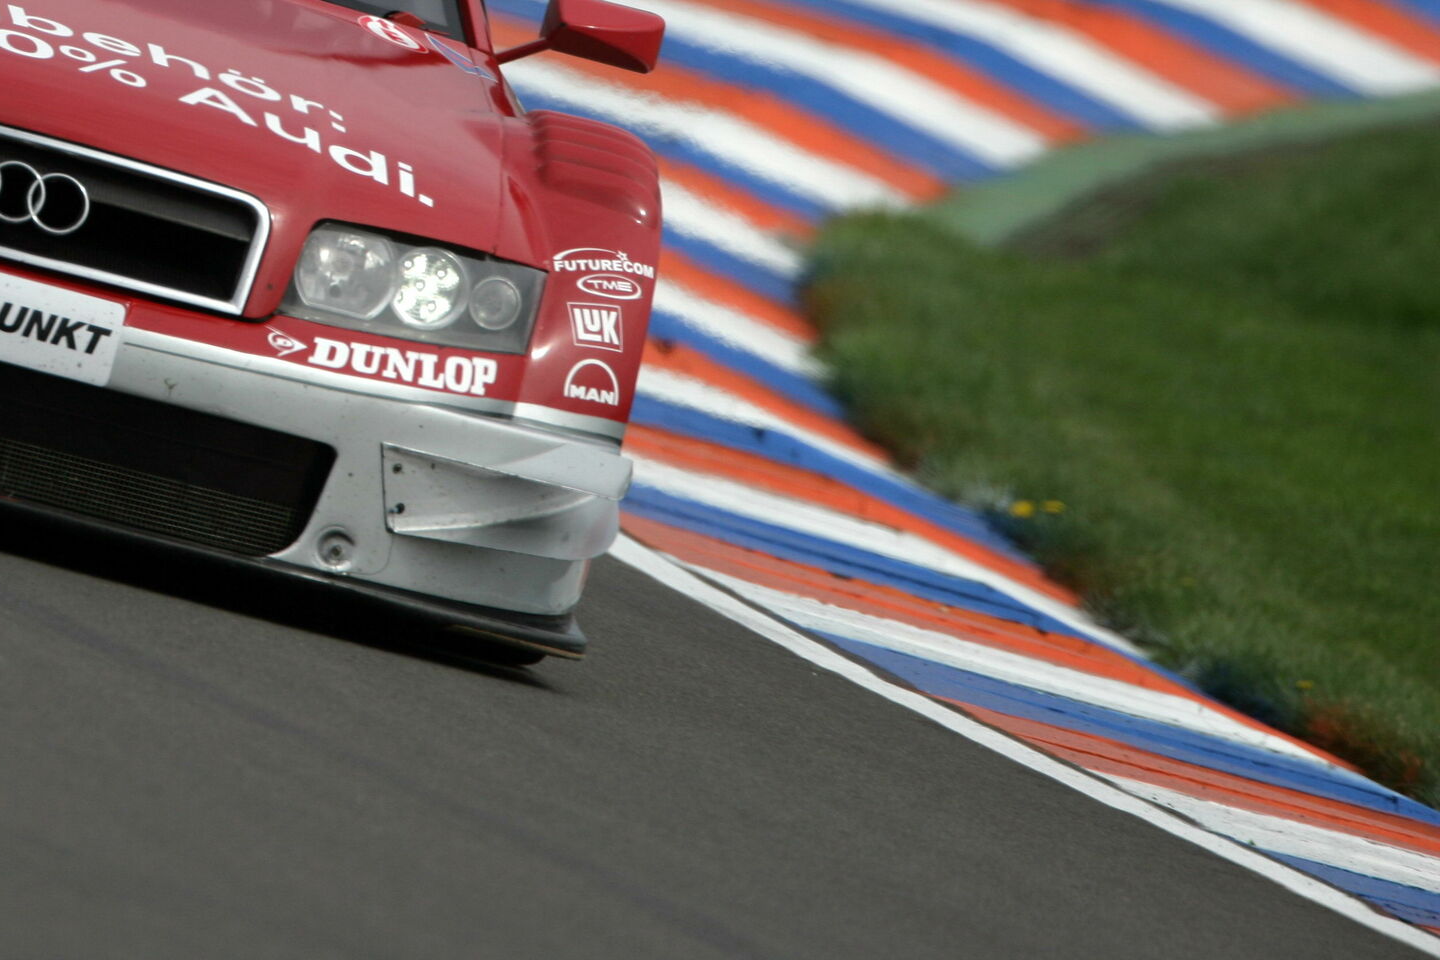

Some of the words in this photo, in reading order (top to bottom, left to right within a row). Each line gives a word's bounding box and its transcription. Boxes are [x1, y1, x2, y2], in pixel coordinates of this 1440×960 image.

[178, 87, 435, 208] Audi.
[553, 258, 655, 280] FUTURECOM
[586, 279, 633, 293] TME
[308, 336, 498, 396] DUNLOP
[569, 383, 616, 406] MAN
